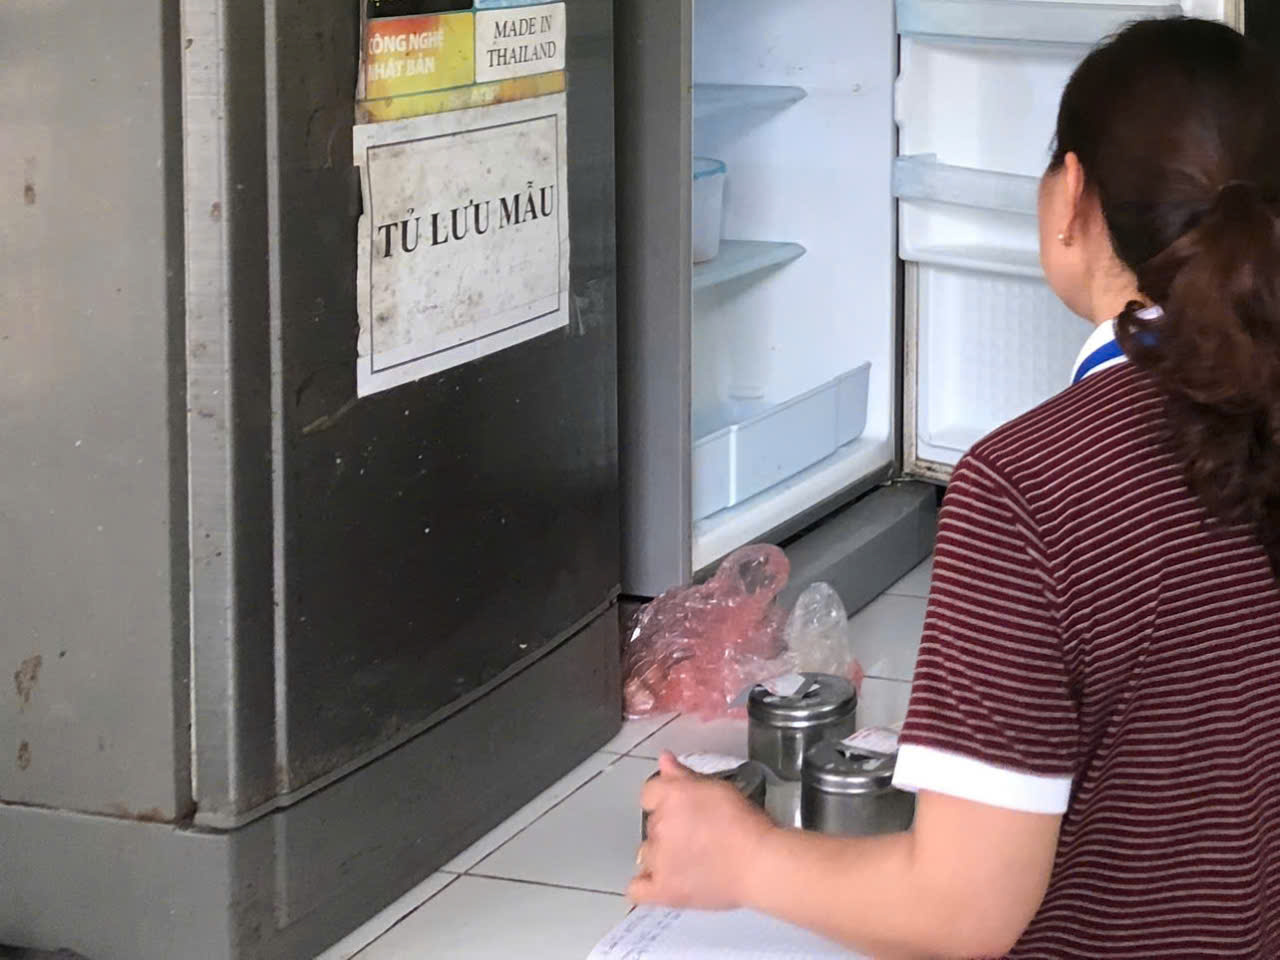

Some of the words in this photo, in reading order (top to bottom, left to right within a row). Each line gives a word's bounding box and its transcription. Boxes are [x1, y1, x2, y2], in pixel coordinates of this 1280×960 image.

[494, 17, 537, 39] MADE
[540, 14, 553, 33] IN
[487, 40, 557, 68] THAILAND
[377, 208, 421, 258] TỦ
[430, 198, 490, 247] LƯU
[499, 180, 554, 229] MẪU
